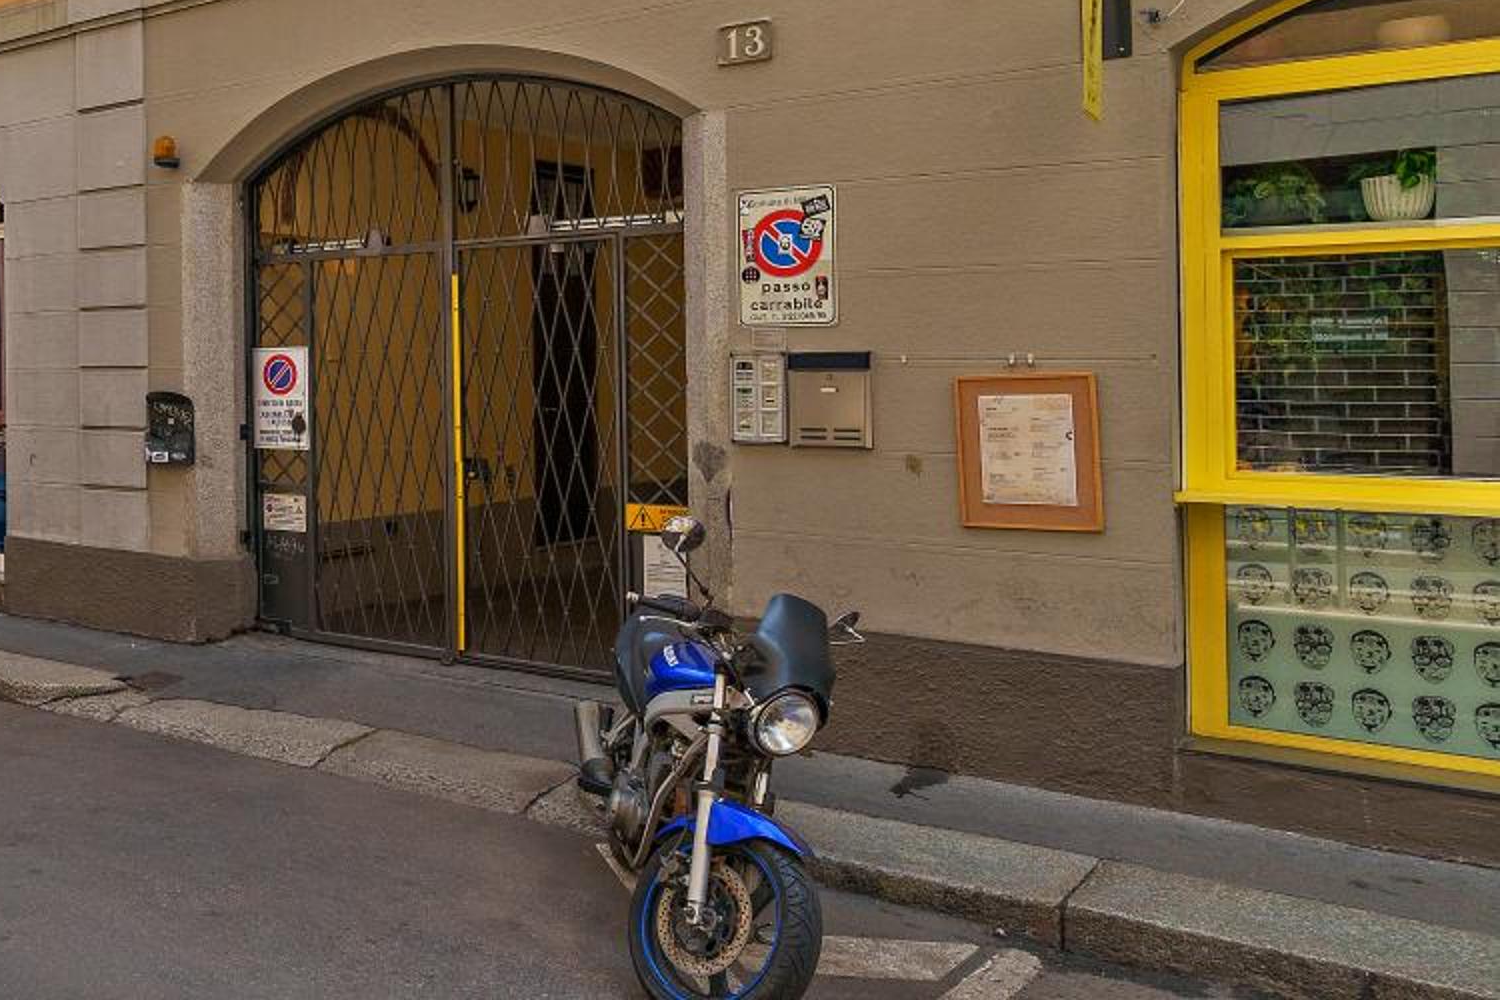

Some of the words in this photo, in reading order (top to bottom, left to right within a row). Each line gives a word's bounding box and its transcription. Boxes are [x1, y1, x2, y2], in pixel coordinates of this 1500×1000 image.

[727, 26, 764, 58] 13
[761, 281, 811, 296] passo
[750, 297, 823, 311] carrabile
